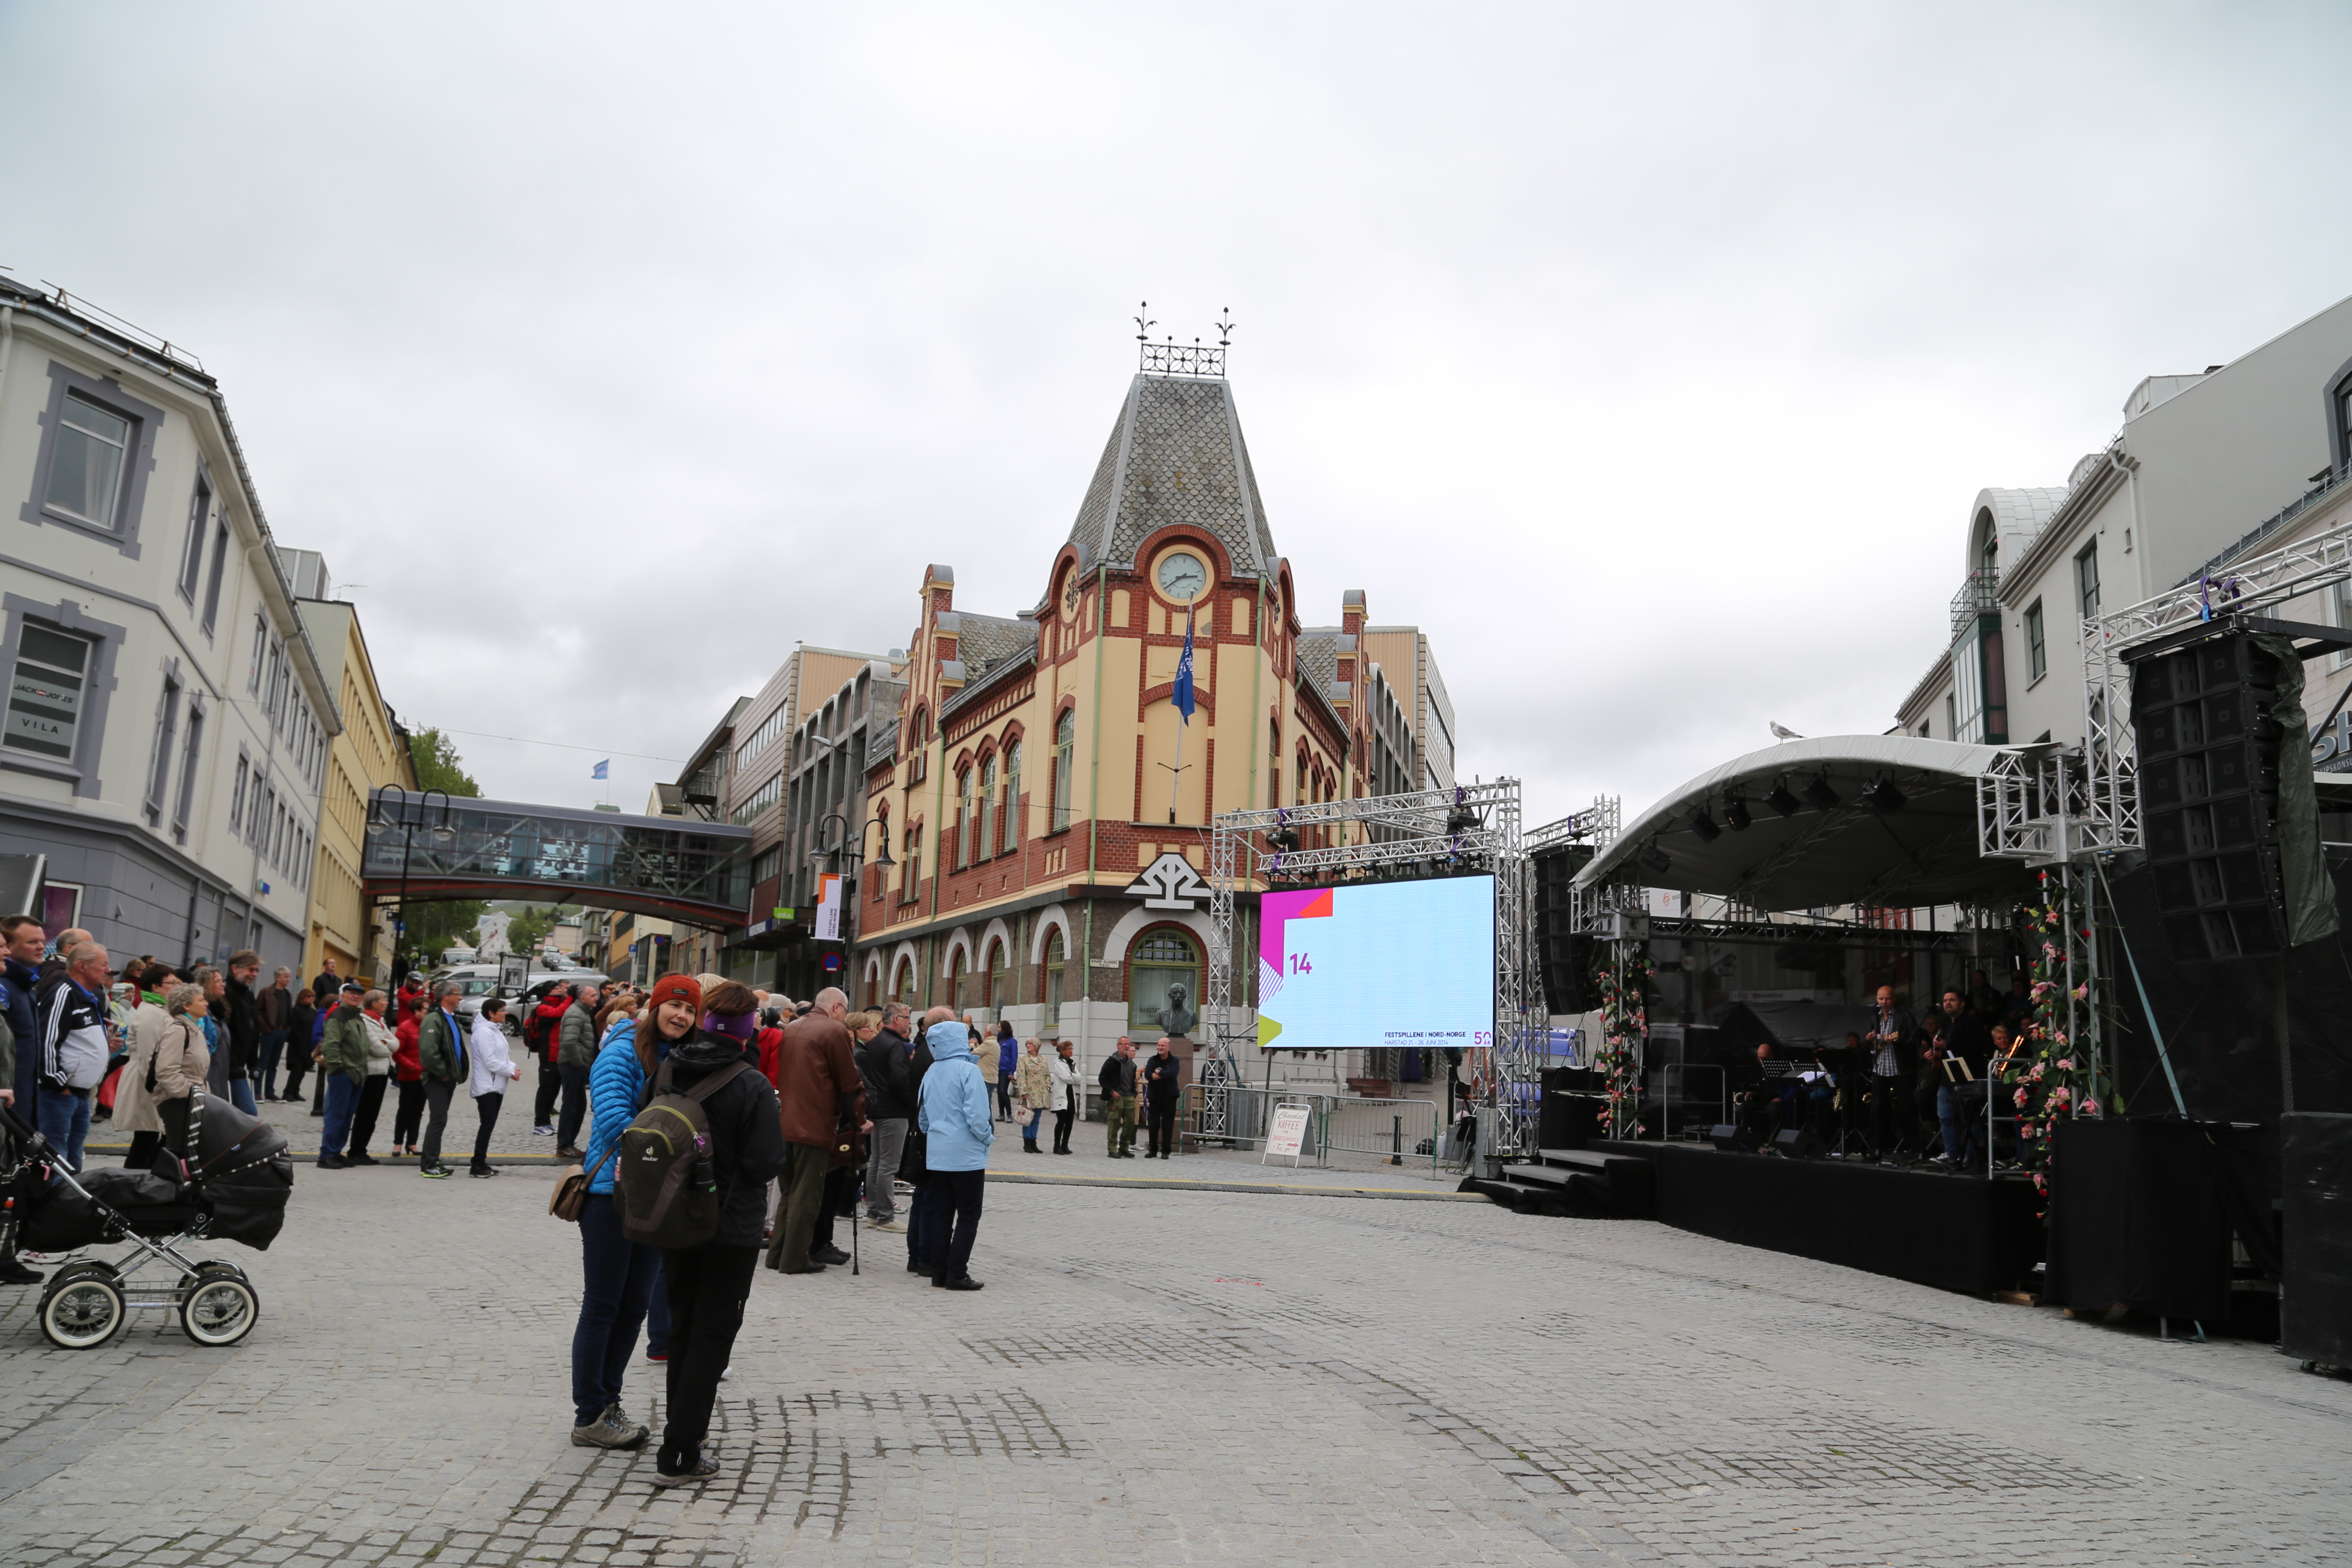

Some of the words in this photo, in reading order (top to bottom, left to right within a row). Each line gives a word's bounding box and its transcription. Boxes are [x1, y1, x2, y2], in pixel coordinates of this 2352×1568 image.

[14, 684, 38, 695] JACK
[46, 692, 74, 704] JONES
[22, 718, 58, 734] VILA
[1290, 952, 1312, 974] 14
[1278, 1111, 1306, 1119] Chocolat
[1277, 1119, 1301, 1130] KAFFEE
